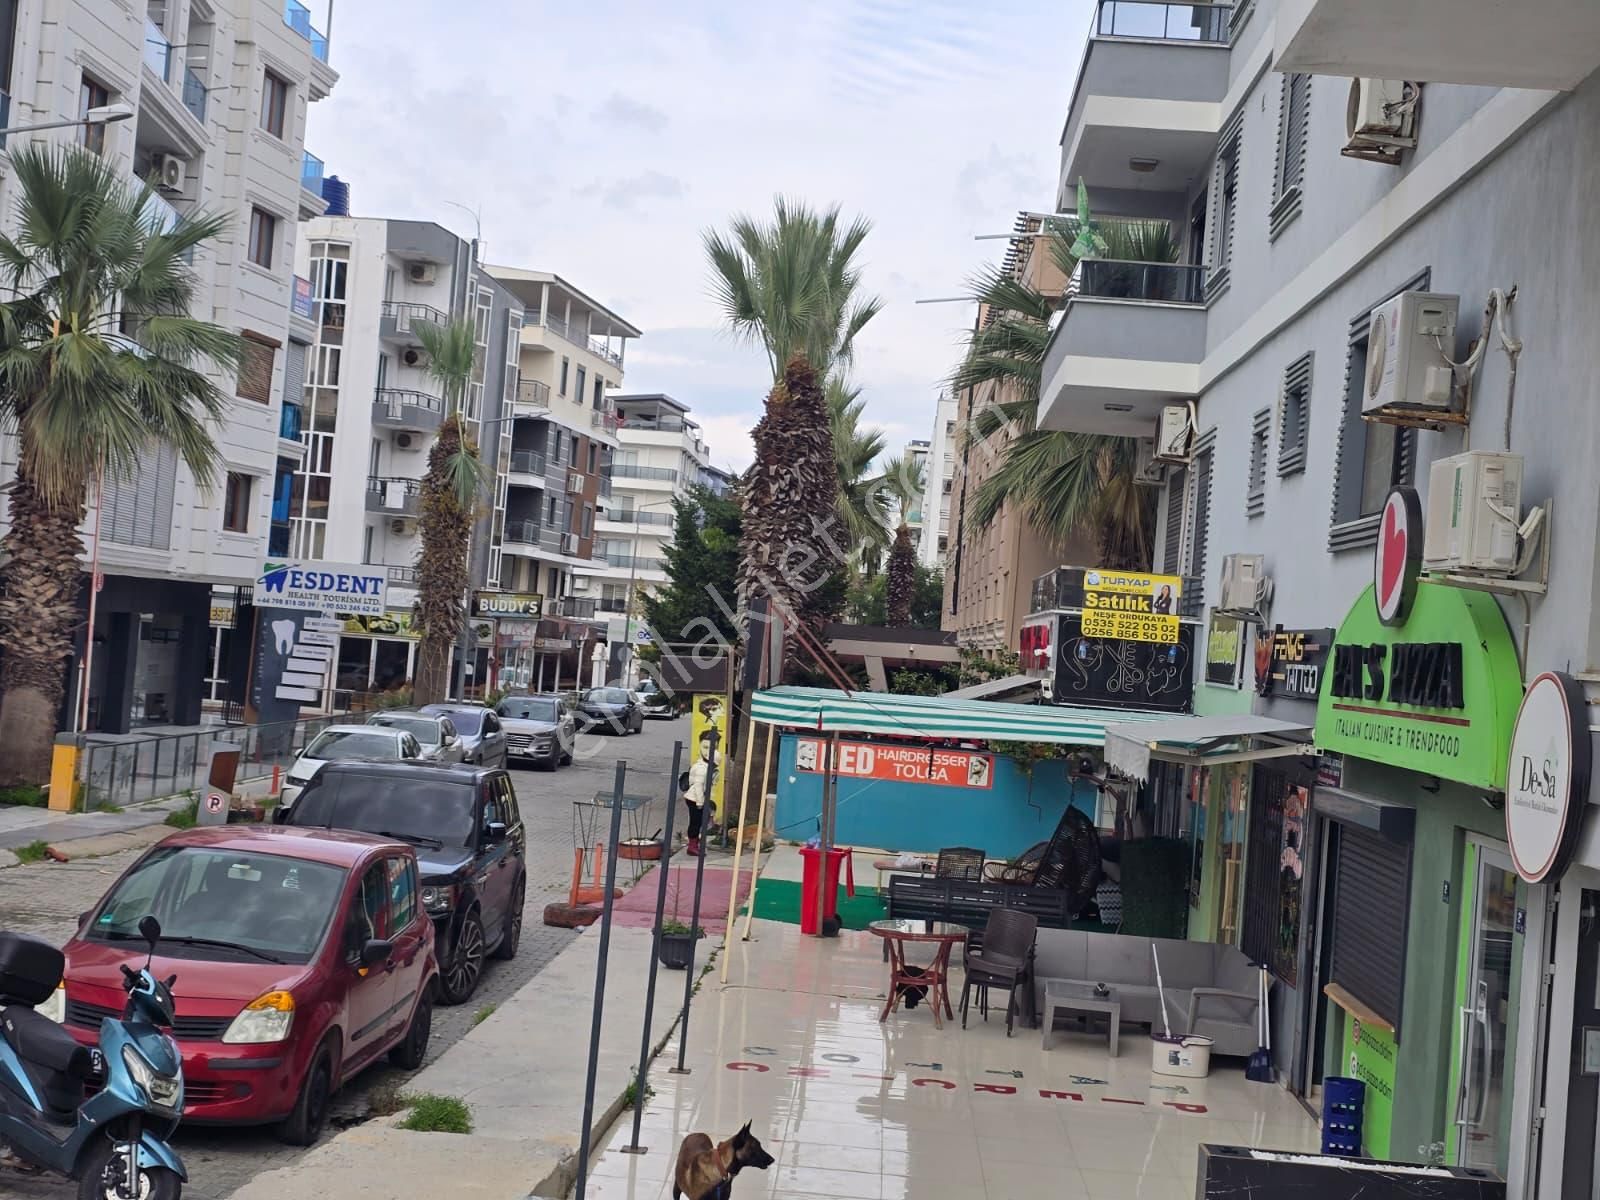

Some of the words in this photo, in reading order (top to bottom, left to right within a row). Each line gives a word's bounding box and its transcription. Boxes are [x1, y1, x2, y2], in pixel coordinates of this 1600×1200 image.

[289, 570, 384, 595] ESDENT
[1101, 576, 1151, 587] TURYAP
[287, 591, 320, 601] HEALTH
[1085, 592, 1151, 612] Satılık
[480, 598, 538, 614] BUDDY'S
[1084, 618, 1115, 628] 0535
[1117, 621, 1140, 630] 522
[1142, 623, 1158, 632] 05
[1160, 624, 1176, 633] 02
[1093, 611, 1118, 620] NEŞE
[1120, 613, 1168, 623] ORDUKAYA
[1142, 631, 1158, 640] 50
[1160, 633, 1176, 642] 02
[1285, 664, 1318, 695] TATTOO
[1387, 642, 1465, 709] PIZZA
[1335, 718, 1362, 738] ITALIAN
[1364, 722, 1394, 745] CUISINE
[1406, 729, 1460, 758] TRENDFOOD
[877, 749, 967, 768] HAIRDRESSER
[893, 763, 949, 781] TOLGA
[1520, 755, 1556, 799] De-Sa
